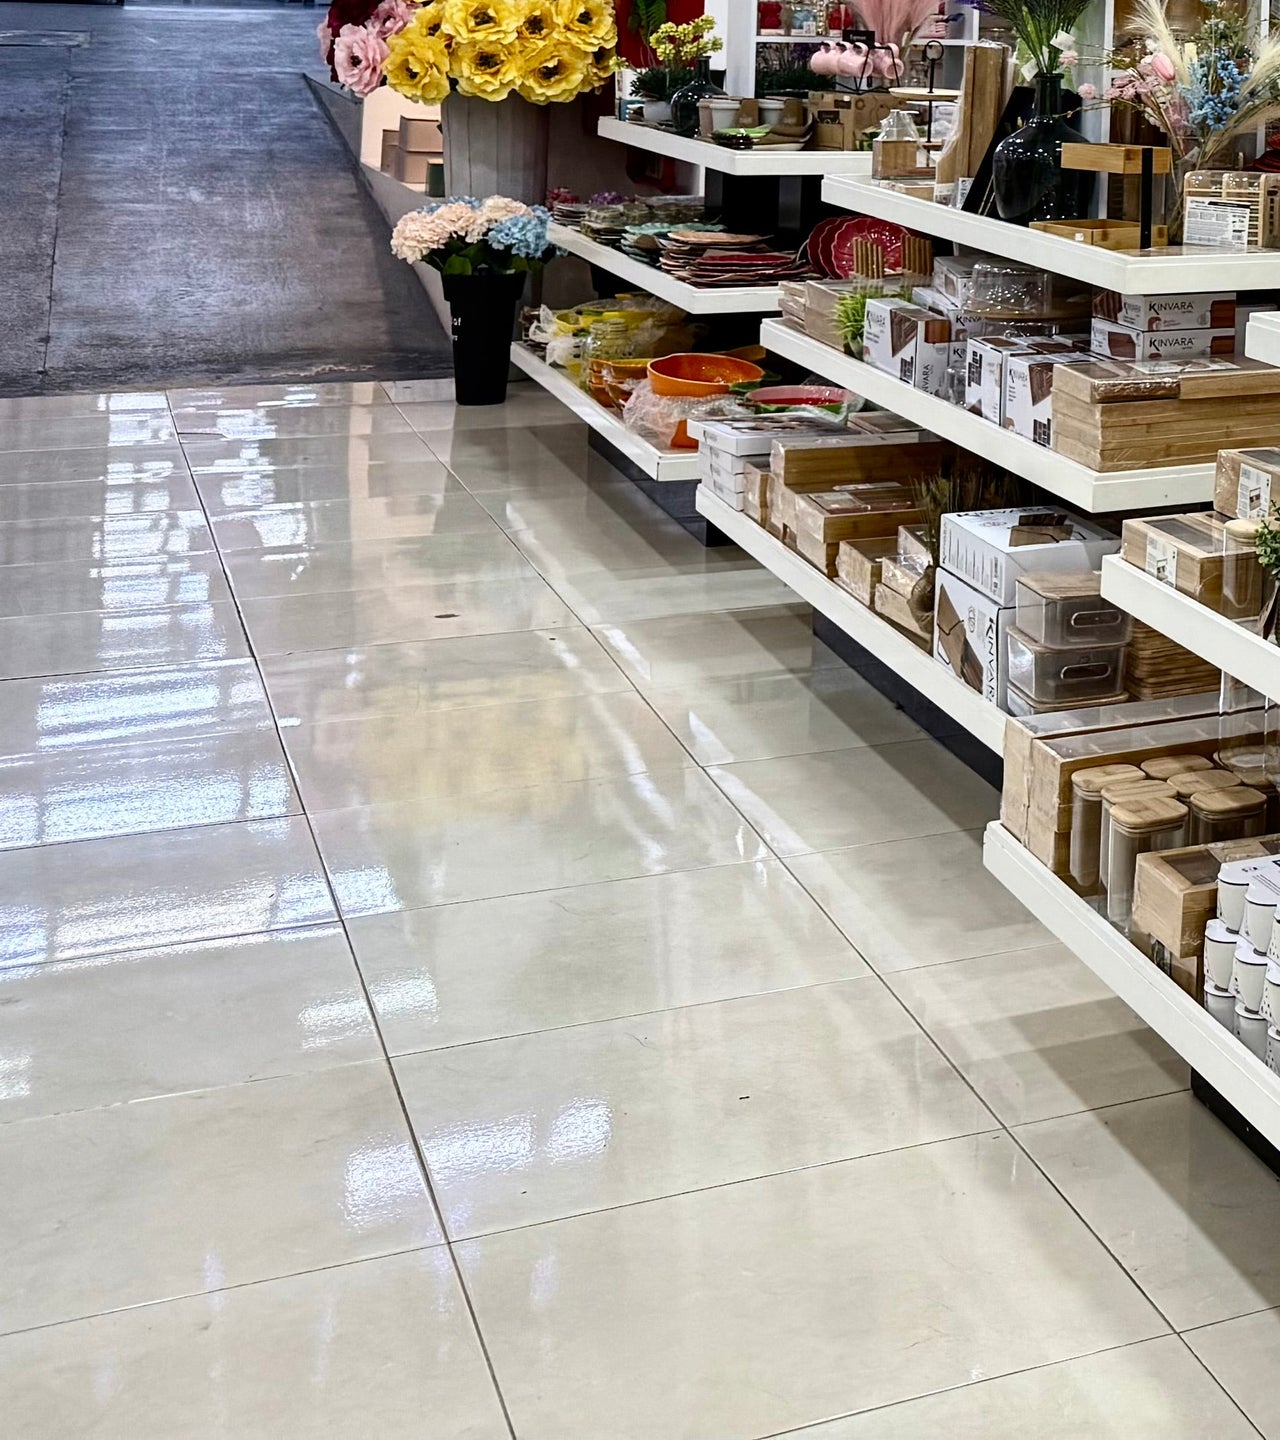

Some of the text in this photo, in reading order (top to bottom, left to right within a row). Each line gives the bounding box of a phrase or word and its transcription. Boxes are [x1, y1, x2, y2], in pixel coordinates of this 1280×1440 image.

[1149, 300, 1194, 316] KINVARA
[1149, 337, 1195, 352] KINVARA
[984, 616, 996, 703] KINVAR
